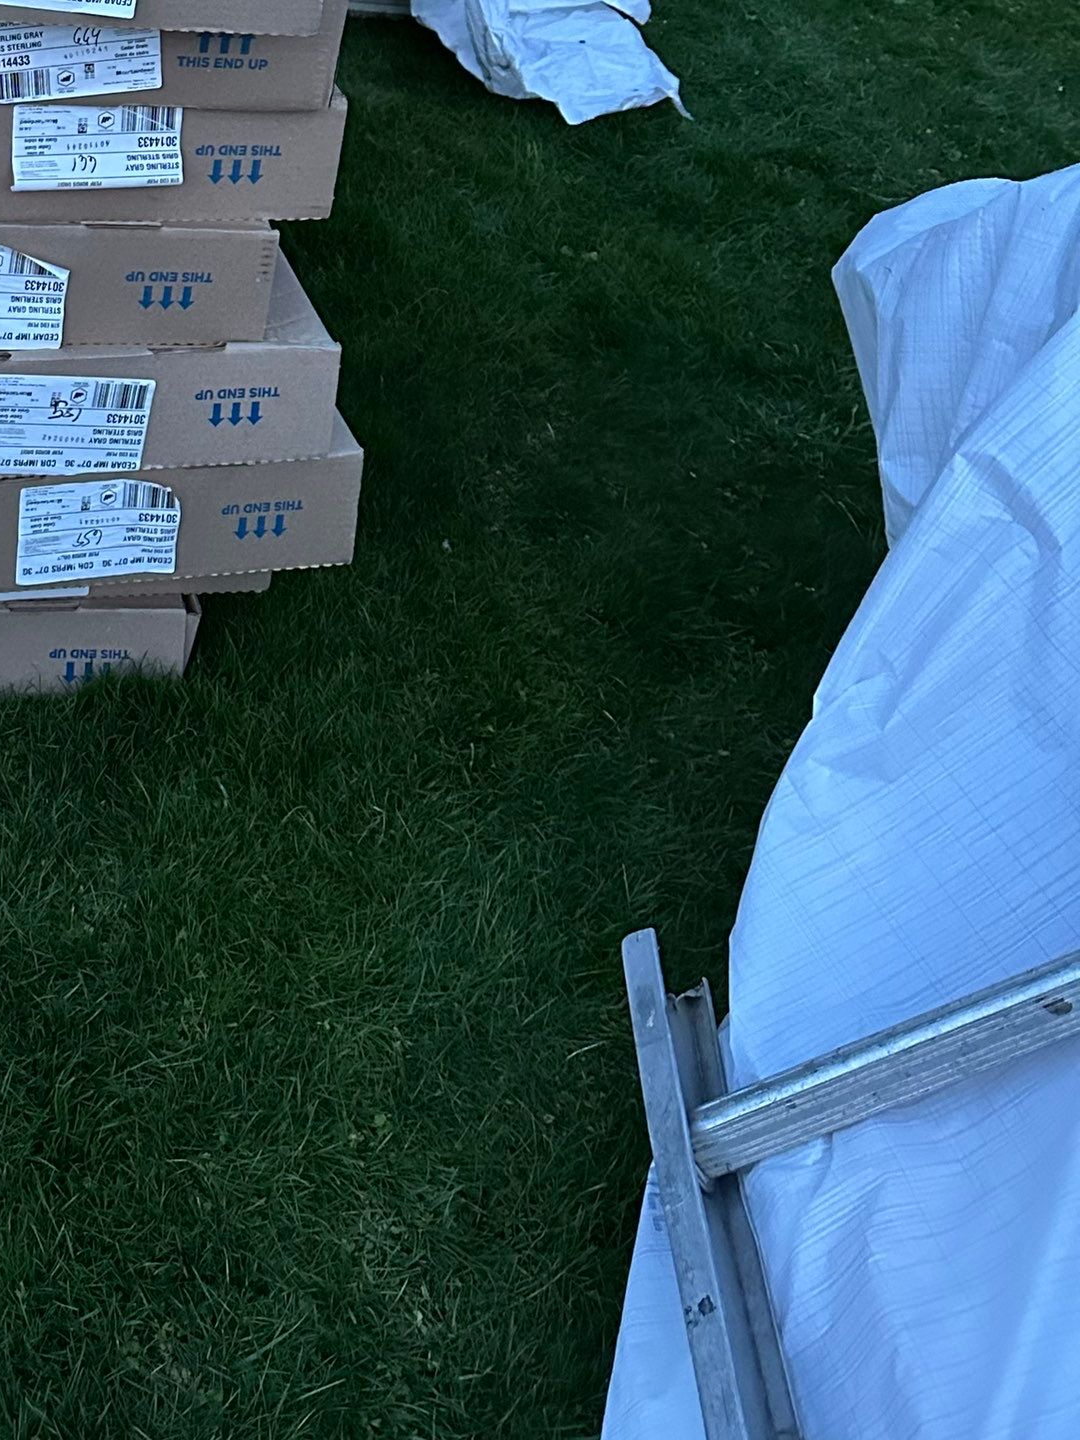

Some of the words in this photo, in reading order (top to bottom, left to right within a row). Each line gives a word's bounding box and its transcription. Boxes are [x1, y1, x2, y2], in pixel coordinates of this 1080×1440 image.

[6, 40, 42, 51] STERLING
[176, 56, 209, 68] THIS
[213, 57, 244, 68] END
[248, 58, 268, 69] UP
[137, 135, 176, 147] 3014433
[195, 144, 214, 156] UP
[218, 144, 246, 156] END
[251, 144, 281, 156] THIS
[125, 163, 143, 171] GRAY
[146, 161, 178, 170] STERLING
[125, 271, 144, 282] UP
[149, 271, 177, 282] END
[182, 271, 212, 282] THIS
[24, 279, 64, 291] 3014433
[10, 295, 43, 303] STERLING
[45, 296, 61, 304] GRIS
[28, 305, 60, 314] STERLING
[15, 332, 30, 340] IMP
[32, 332, 58, 341] CEDAR
[194, 389, 213, 401] UP
[217, 387, 245, 400] END
[249, 385, 279, 398] THIS
[106, 413, 145, 424] 3014433
[13, 458, 37, 467] IMPRS
[93, 460, 108, 468] IMP
[111, 460, 136, 469] CEDAR
[220, 504, 239, 516] UP
[243, 501, 271, 514] END
[273, 498, 302, 512] THIS
[138, 511, 177, 524] 3014433
[49, 648, 66, 658] UP
[70, 649, 96, 659] END
[100, 649, 129, 659] THIS
